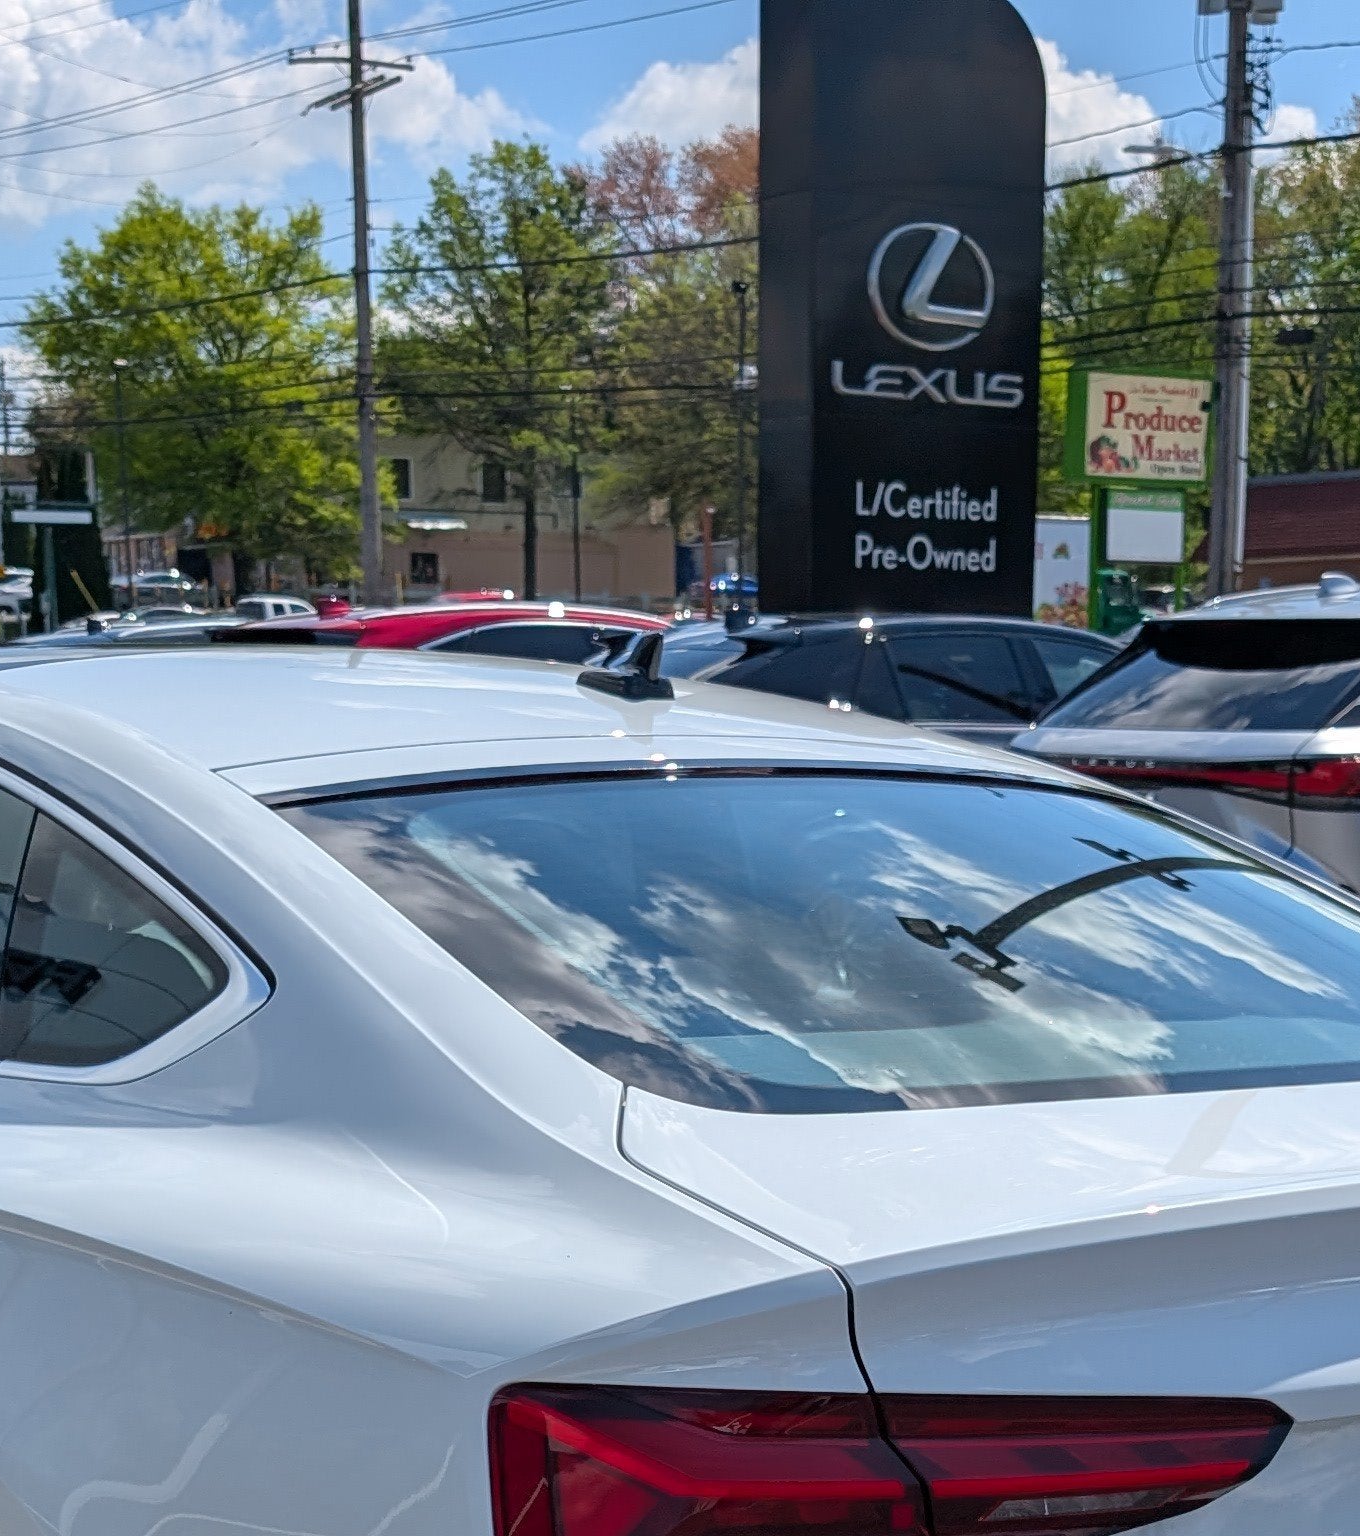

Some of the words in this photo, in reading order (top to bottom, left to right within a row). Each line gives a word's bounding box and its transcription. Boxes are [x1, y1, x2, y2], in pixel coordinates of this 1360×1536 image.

[830, 360, 1025, 408] LEXUS
[1102, 390, 1203, 434] Produce
[1131, 433, 1200, 463] Market
[855, 479, 998, 523] L/Certified
[854, 532, 997, 573] Pre-Owned
